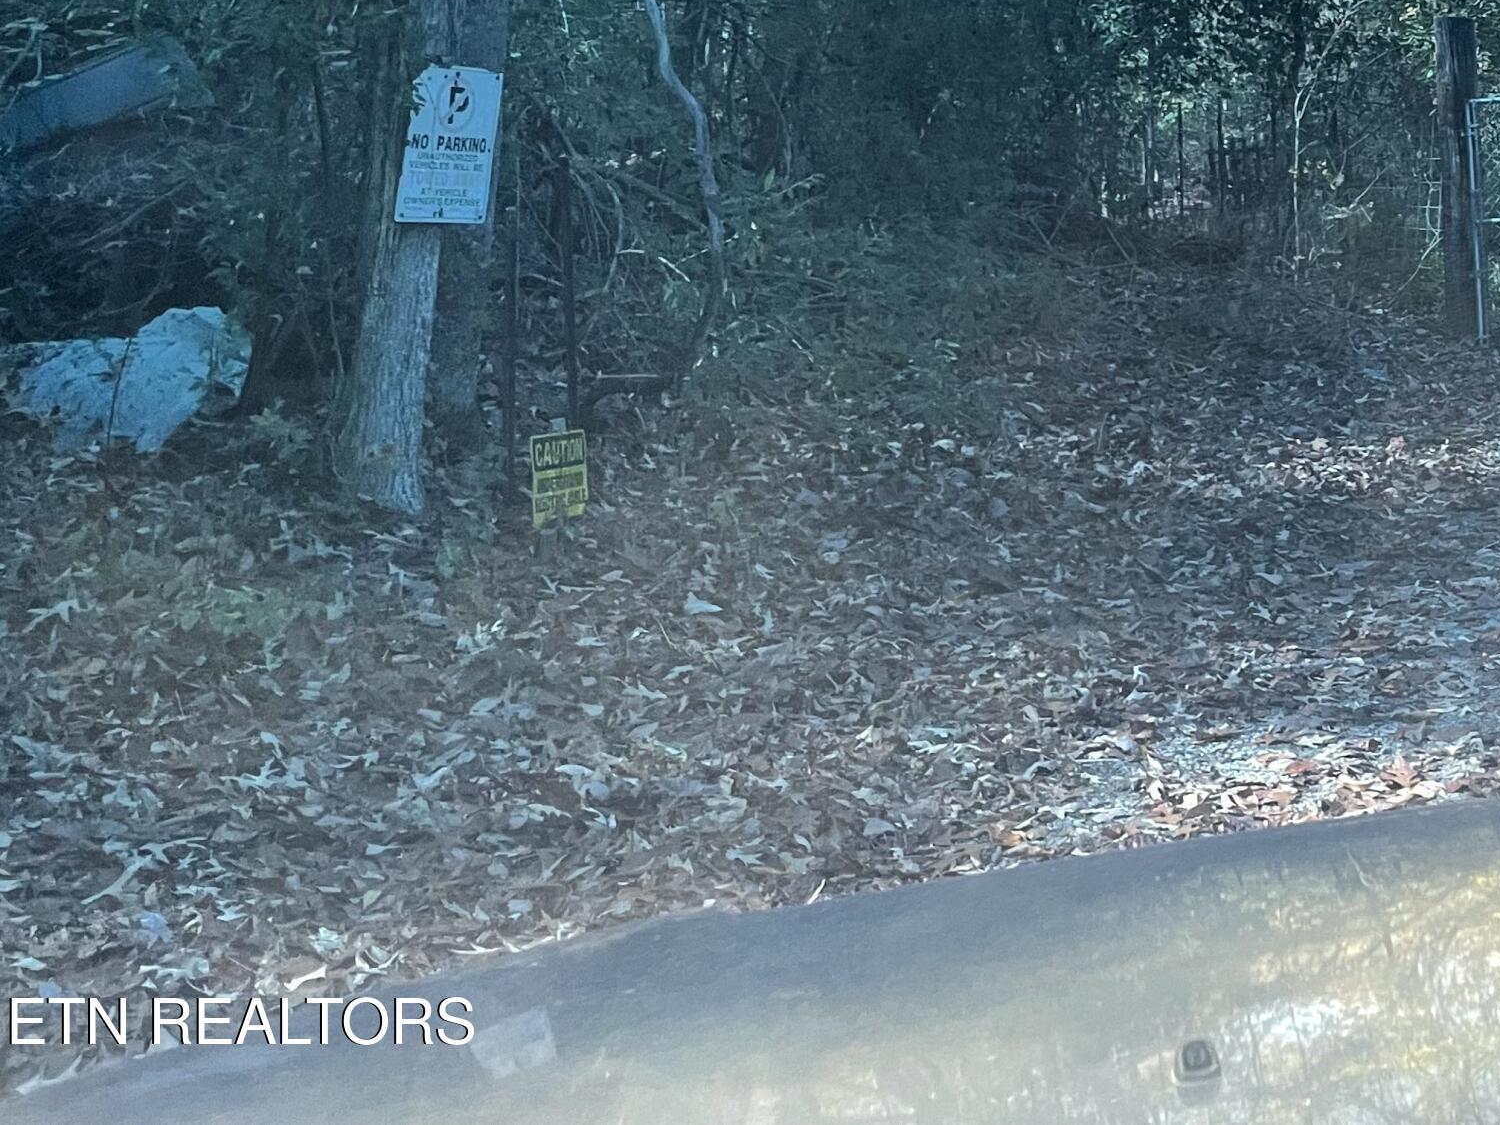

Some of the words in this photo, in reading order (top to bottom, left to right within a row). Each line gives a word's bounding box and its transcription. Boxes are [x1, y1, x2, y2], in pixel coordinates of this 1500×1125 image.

[411, 133, 429, 149] NO
[436, 135, 487, 153] PARKING
[409, 160, 449, 170] VEHICLES
[473, 163, 484, 172] BE
[534, 437, 584, 468] CAUTION
